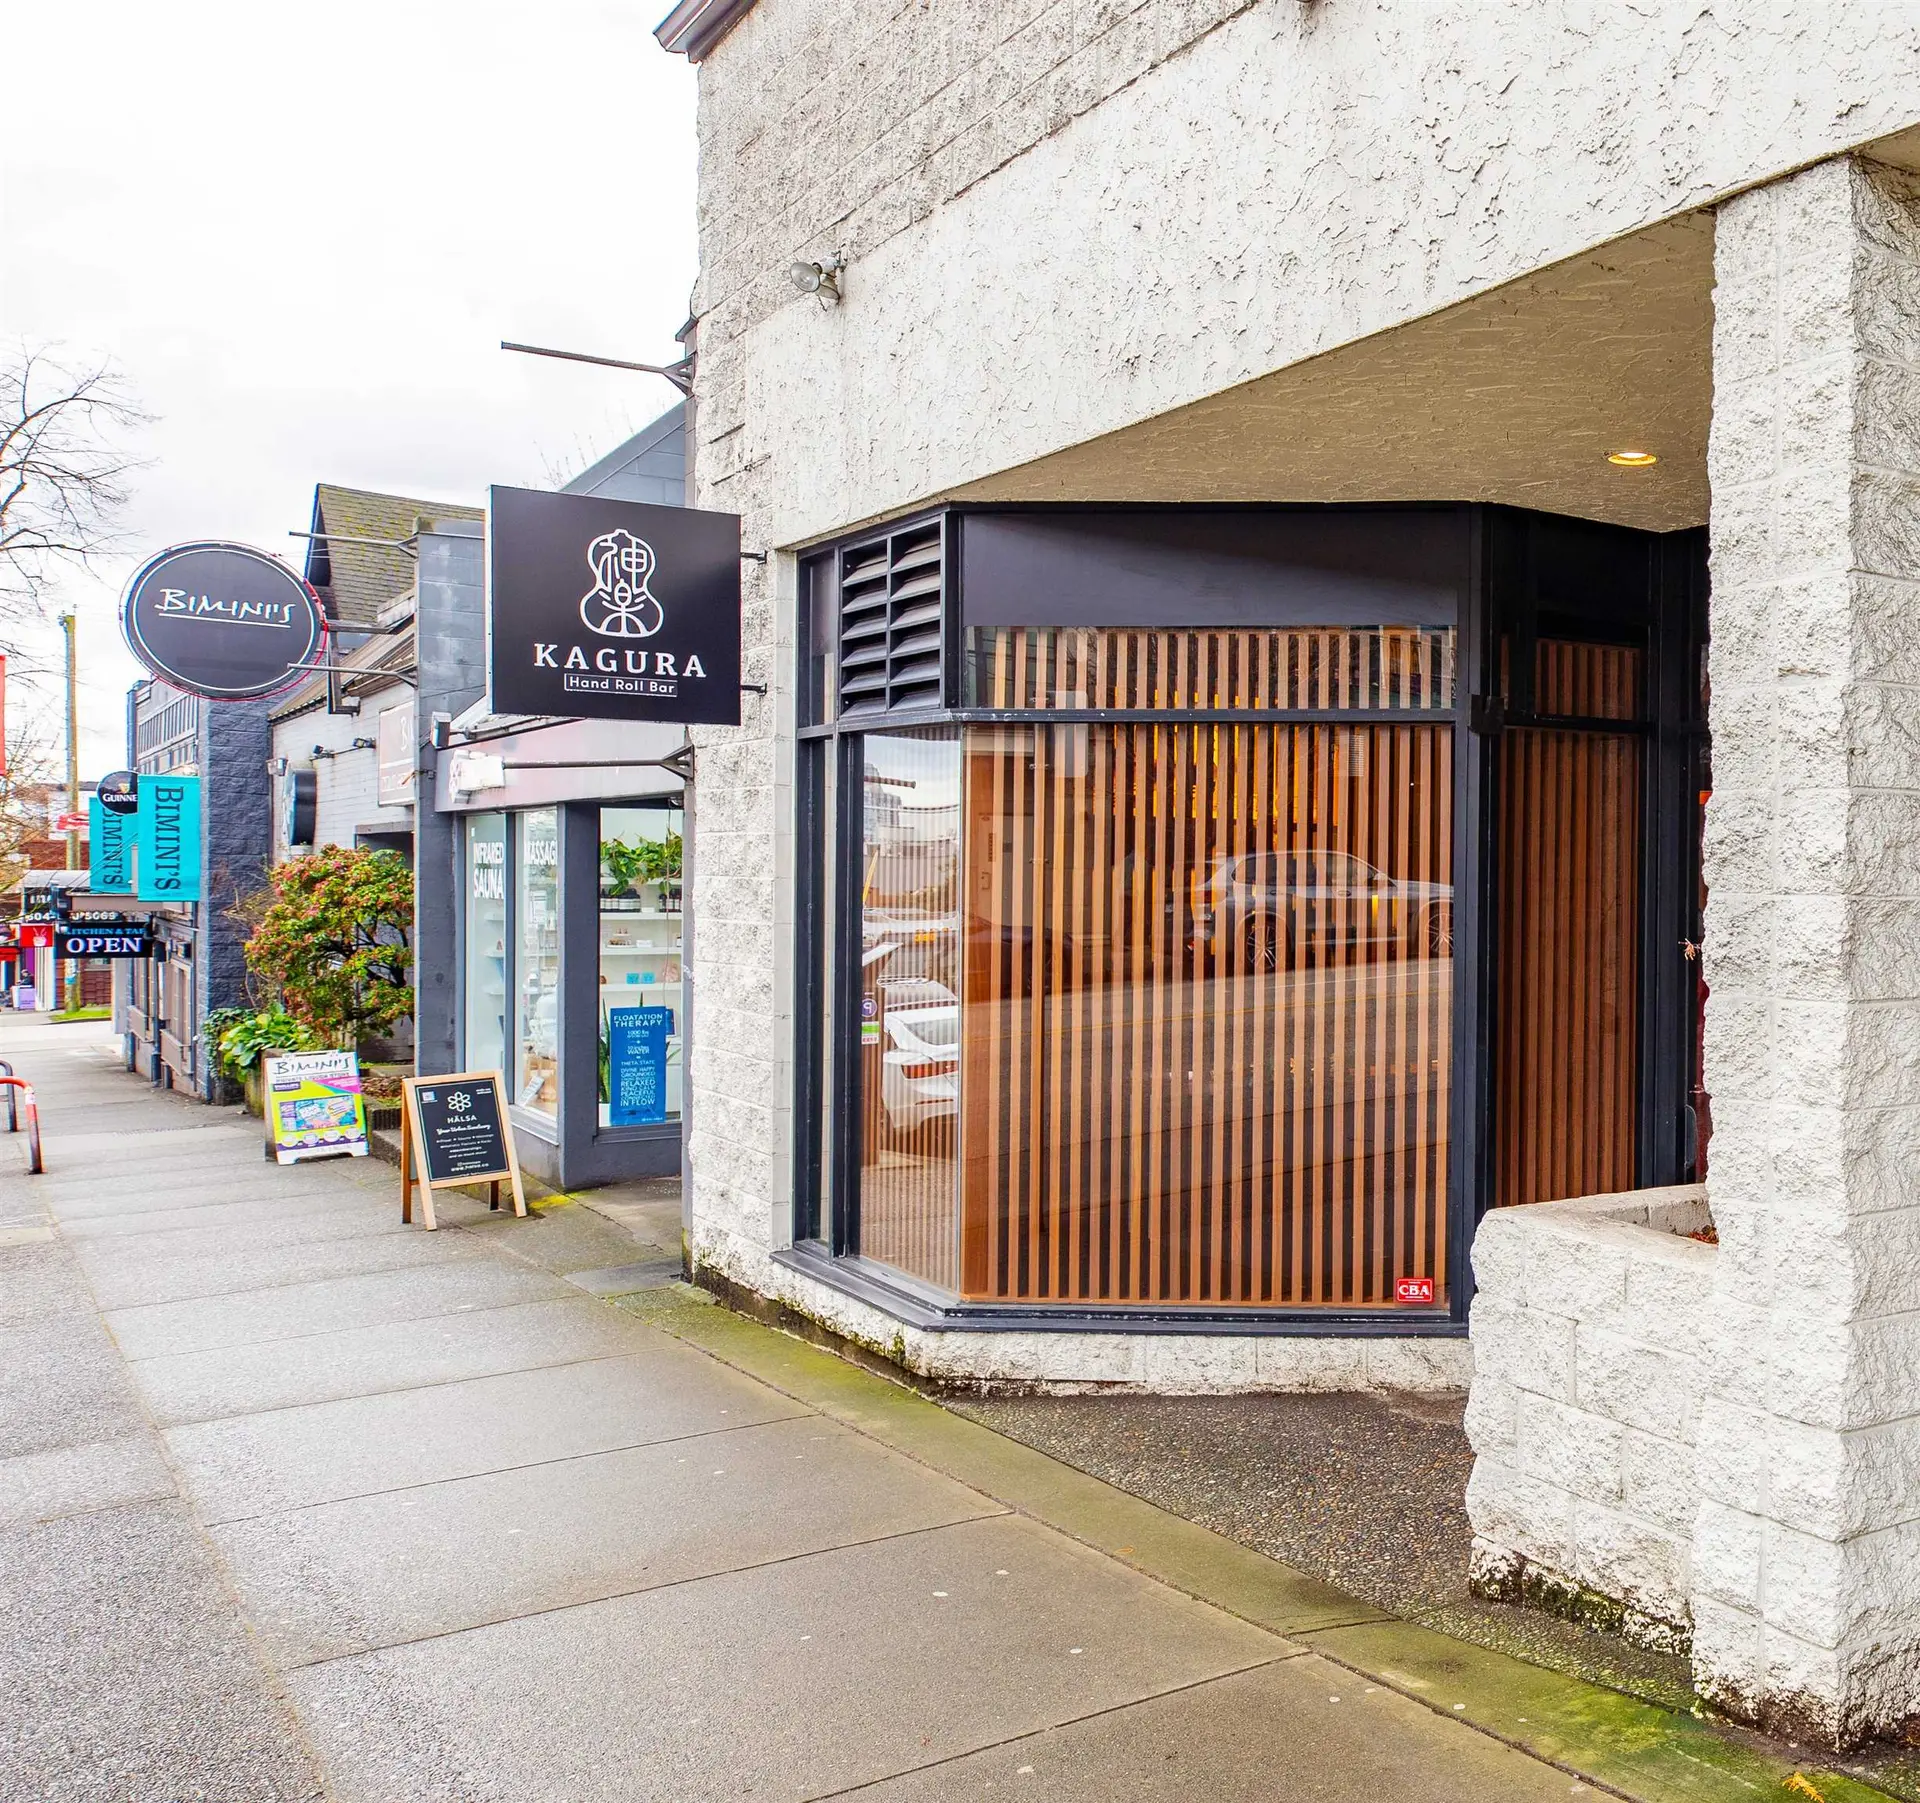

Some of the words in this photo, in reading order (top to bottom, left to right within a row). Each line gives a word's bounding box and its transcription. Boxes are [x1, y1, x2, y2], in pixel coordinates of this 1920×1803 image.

[154, 588, 296, 623] BIMINI'S
[533, 643, 707, 678] KAGURA
[569, 676, 609, 690] Hand
[615, 680, 644, 692] Roll
[650, 682, 675, 694] Bar
[102, 793, 138, 802] GUINNE
[153, 785, 184, 891] BIMINI'S
[523, 840, 558, 866] MASSAG
[473, 867, 504, 899] SAUNA
[66, 937, 142, 953] OPEN
[273, 1057, 350, 1075] BIMINI'S
[620, 1079, 656, 1087] RELAXED
[631, 1098, 656, 1106] FLOW
[1399, 1284, 1430, 1296] CBA
